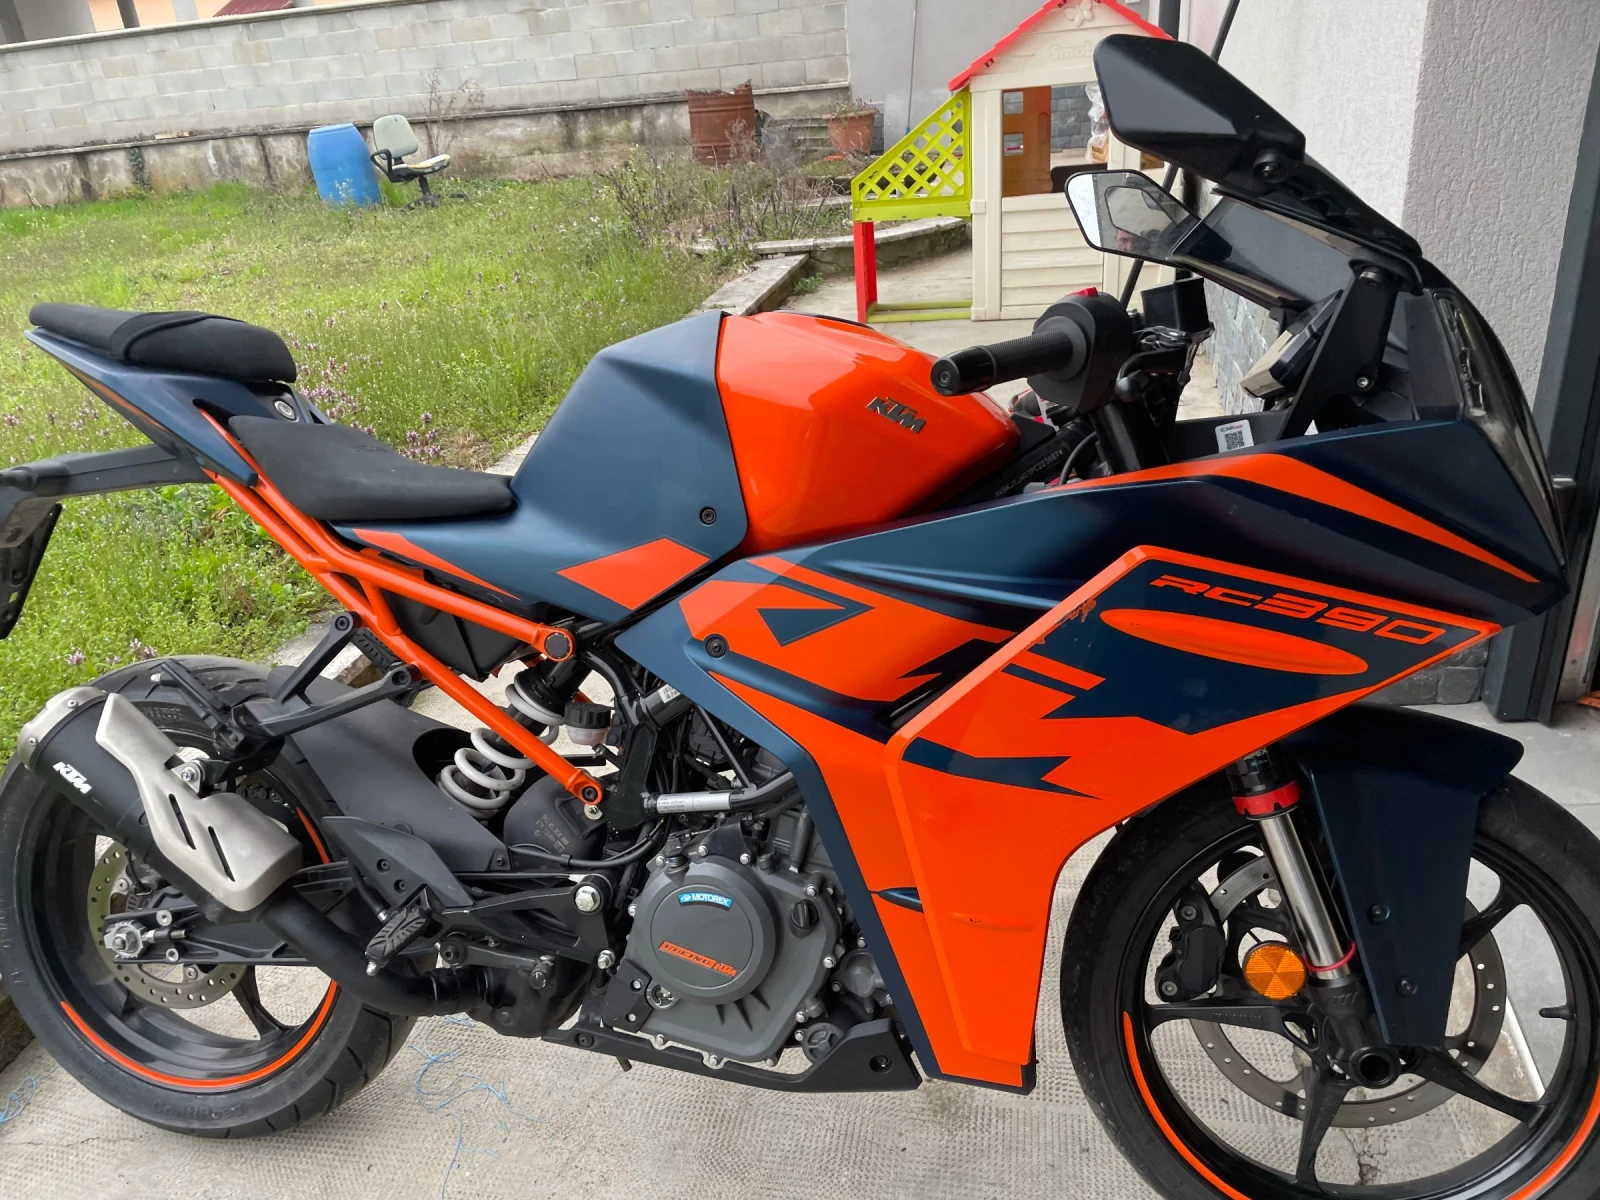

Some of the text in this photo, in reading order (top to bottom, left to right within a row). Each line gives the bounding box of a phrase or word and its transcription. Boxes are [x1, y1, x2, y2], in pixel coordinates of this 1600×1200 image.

[1049, 39, 1094, 61] Smob
[865, 396, 927, 434] KTM
[1150, 574, 1446, 645] RC390
[52, 761, 92, 794] KTM
[691, 893, 730, 906] MOTOREX
